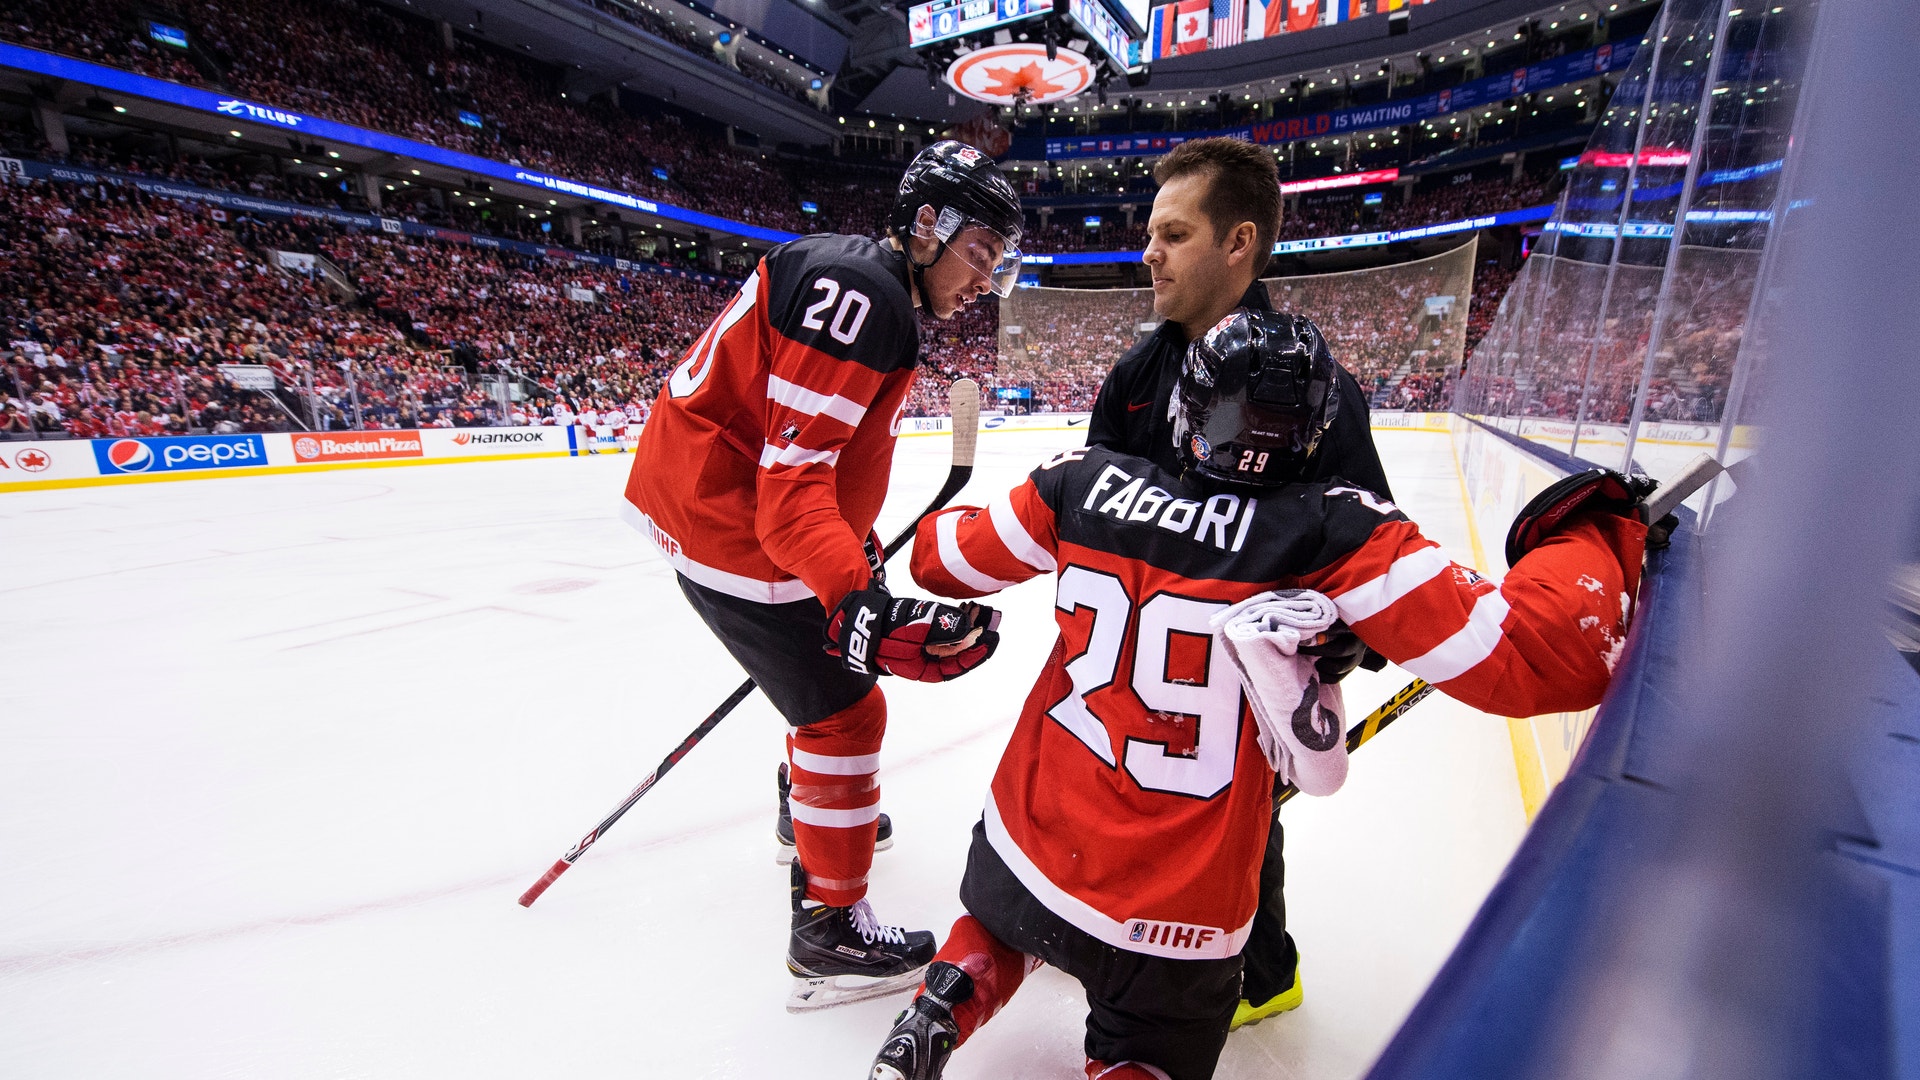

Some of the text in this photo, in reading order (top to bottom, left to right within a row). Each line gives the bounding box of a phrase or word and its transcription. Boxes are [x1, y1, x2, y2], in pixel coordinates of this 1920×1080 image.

[1004, 0, 1019, 17] 0
[939, 13, 952, 34] 0
[246, 104, 302, 126] TELUS
[1252, 114, 1331, 144] WORLD
[1335, 115, 1348, 128] IS
[1351, 105, 1412, 126] WAITING
[52, 169, 79, 180] 2015
[544, 176, 556, 189] LA
[1452, 173, 1472, 185] 304
[384, 222, 399, 231] 119
[616, 260, 631, 270] 120
[802, 277, 871, 345] 20
[914, 419, 935, 431] Mobil
[1369, 413, 1410, 427] Canada
[163, 438, 259, 468] pepsi
[321, 436, 421, 455] Boston Pizza
[1237, 450, 1270, 473] 29
[1082, 464, 1259, 553] FABBRI
[652, 525, 679, 557] IIHF
[1046, 562, 1243, 800] 29
[1148, 924, 1216, 949] IIHF
